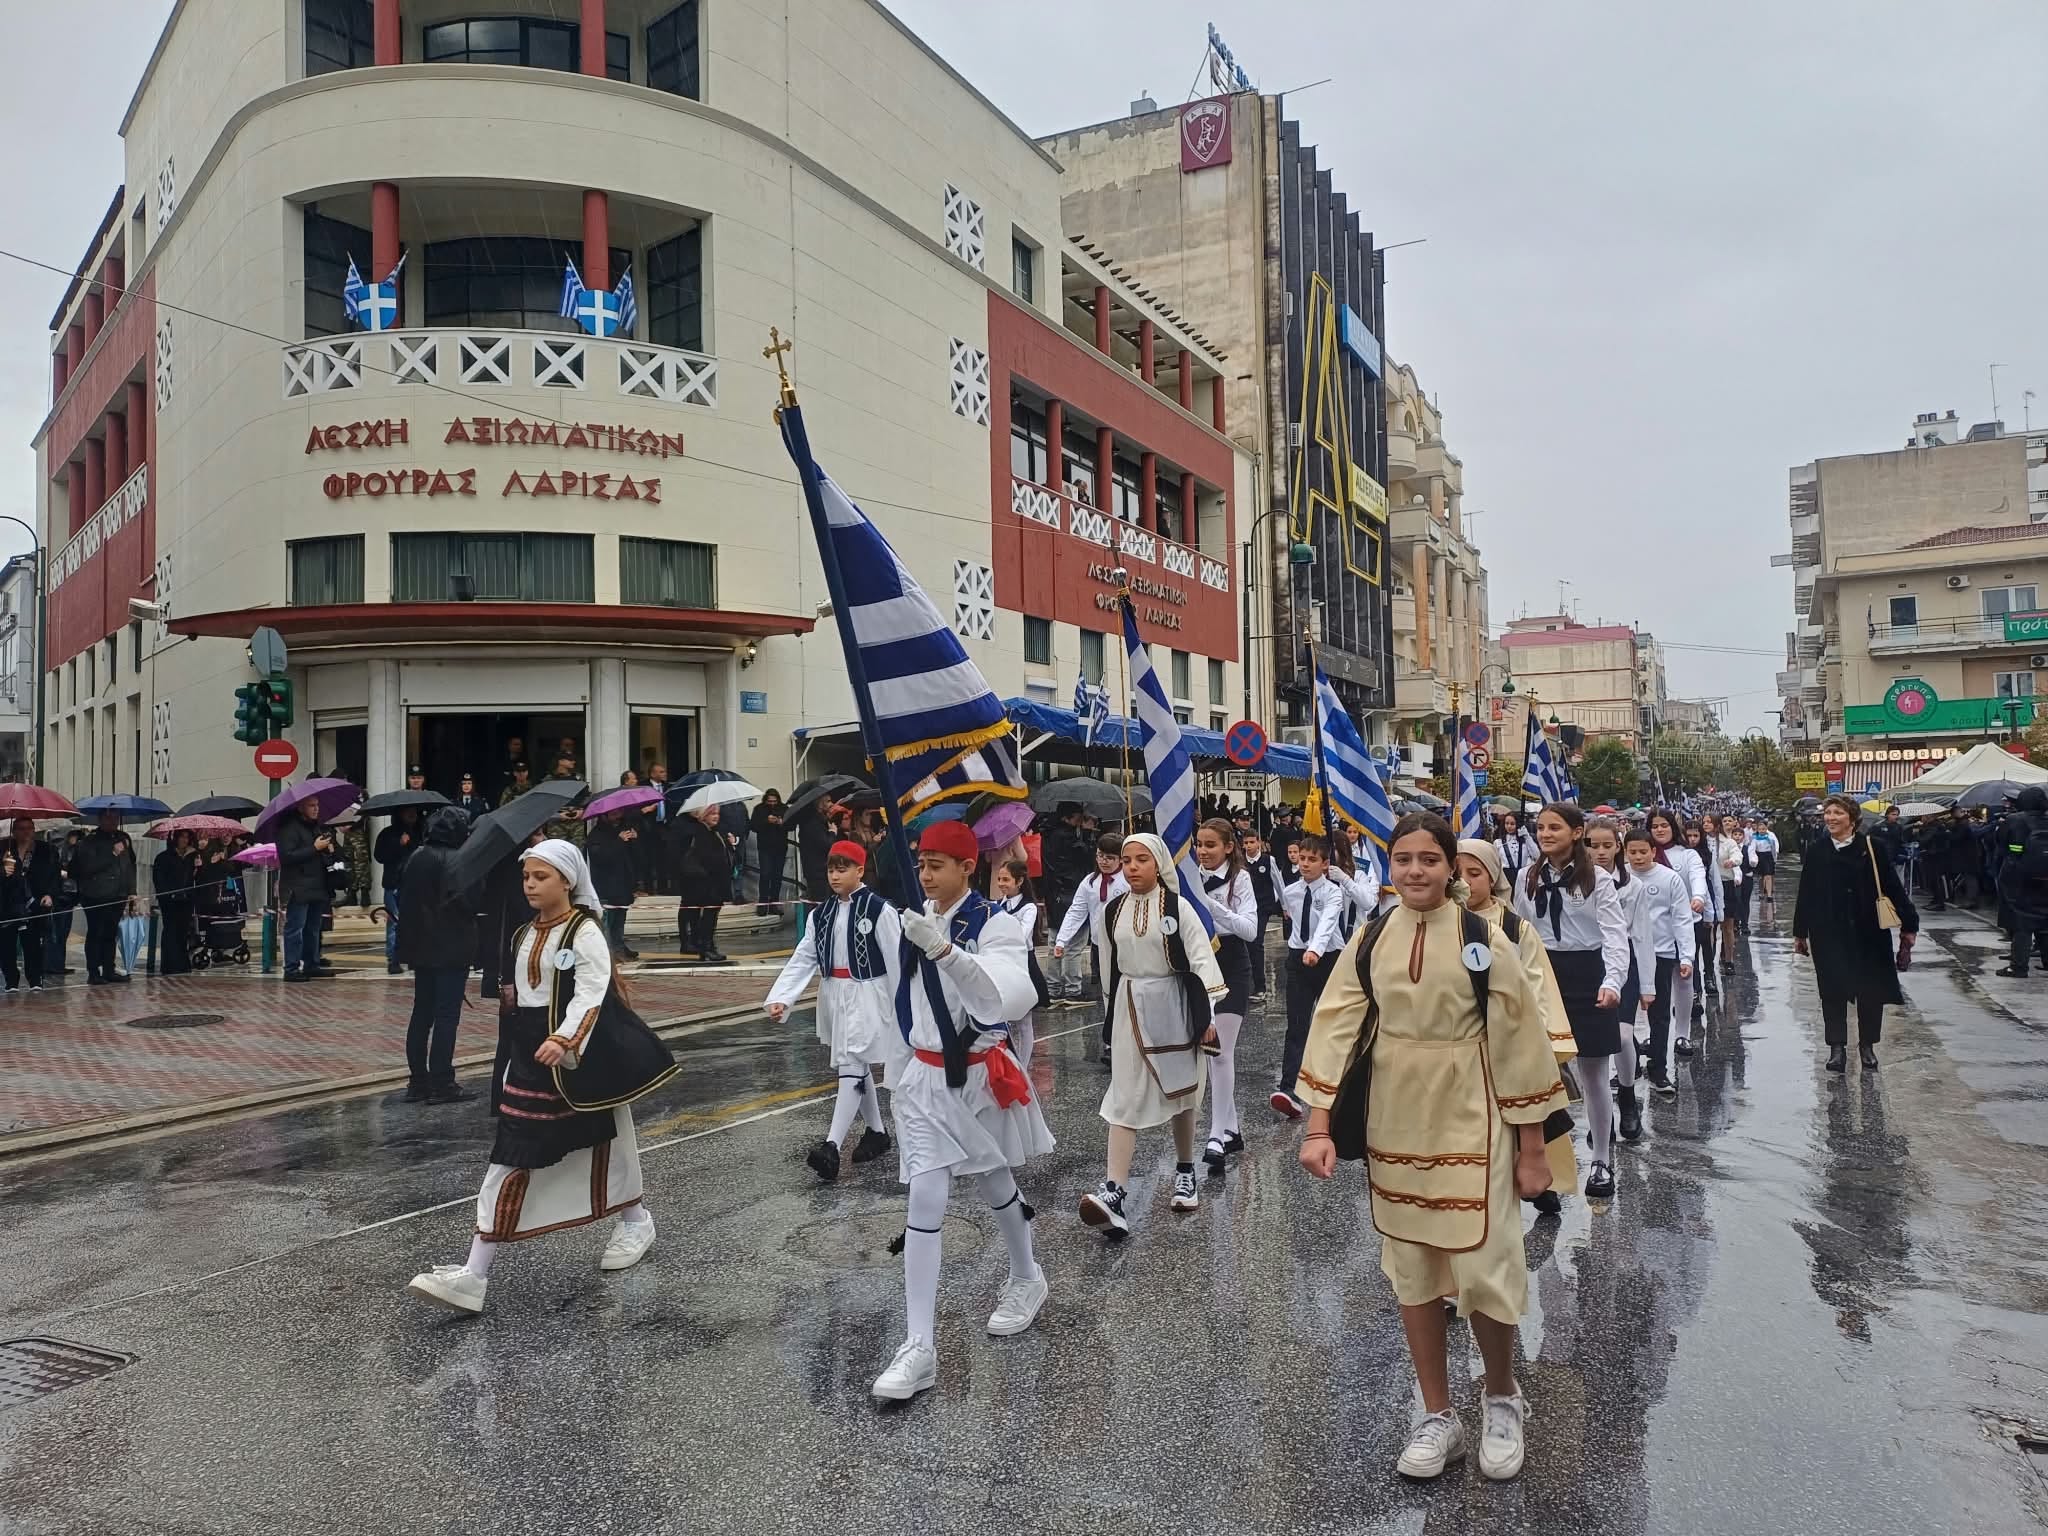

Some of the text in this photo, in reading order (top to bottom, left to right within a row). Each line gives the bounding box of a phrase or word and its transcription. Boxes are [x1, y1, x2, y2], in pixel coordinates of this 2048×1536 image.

[305, 417, 684, 458] ΛΕΣΧΗ ΑΞΙΩΜΑΤΙΚΩΝ
[322, 469, 662, 504] ΦΡΟΥΡΑΣ ΛΑΡΙΣΑΣ
[1088, 561, 1116, 585] ΛΕΣΧ
[1145, 607, 1183, 630] ΛΑΡΙΣΑΣ
[1164, 919, 1171, 931] 1
[1471, 947, 1480, 966] 1
